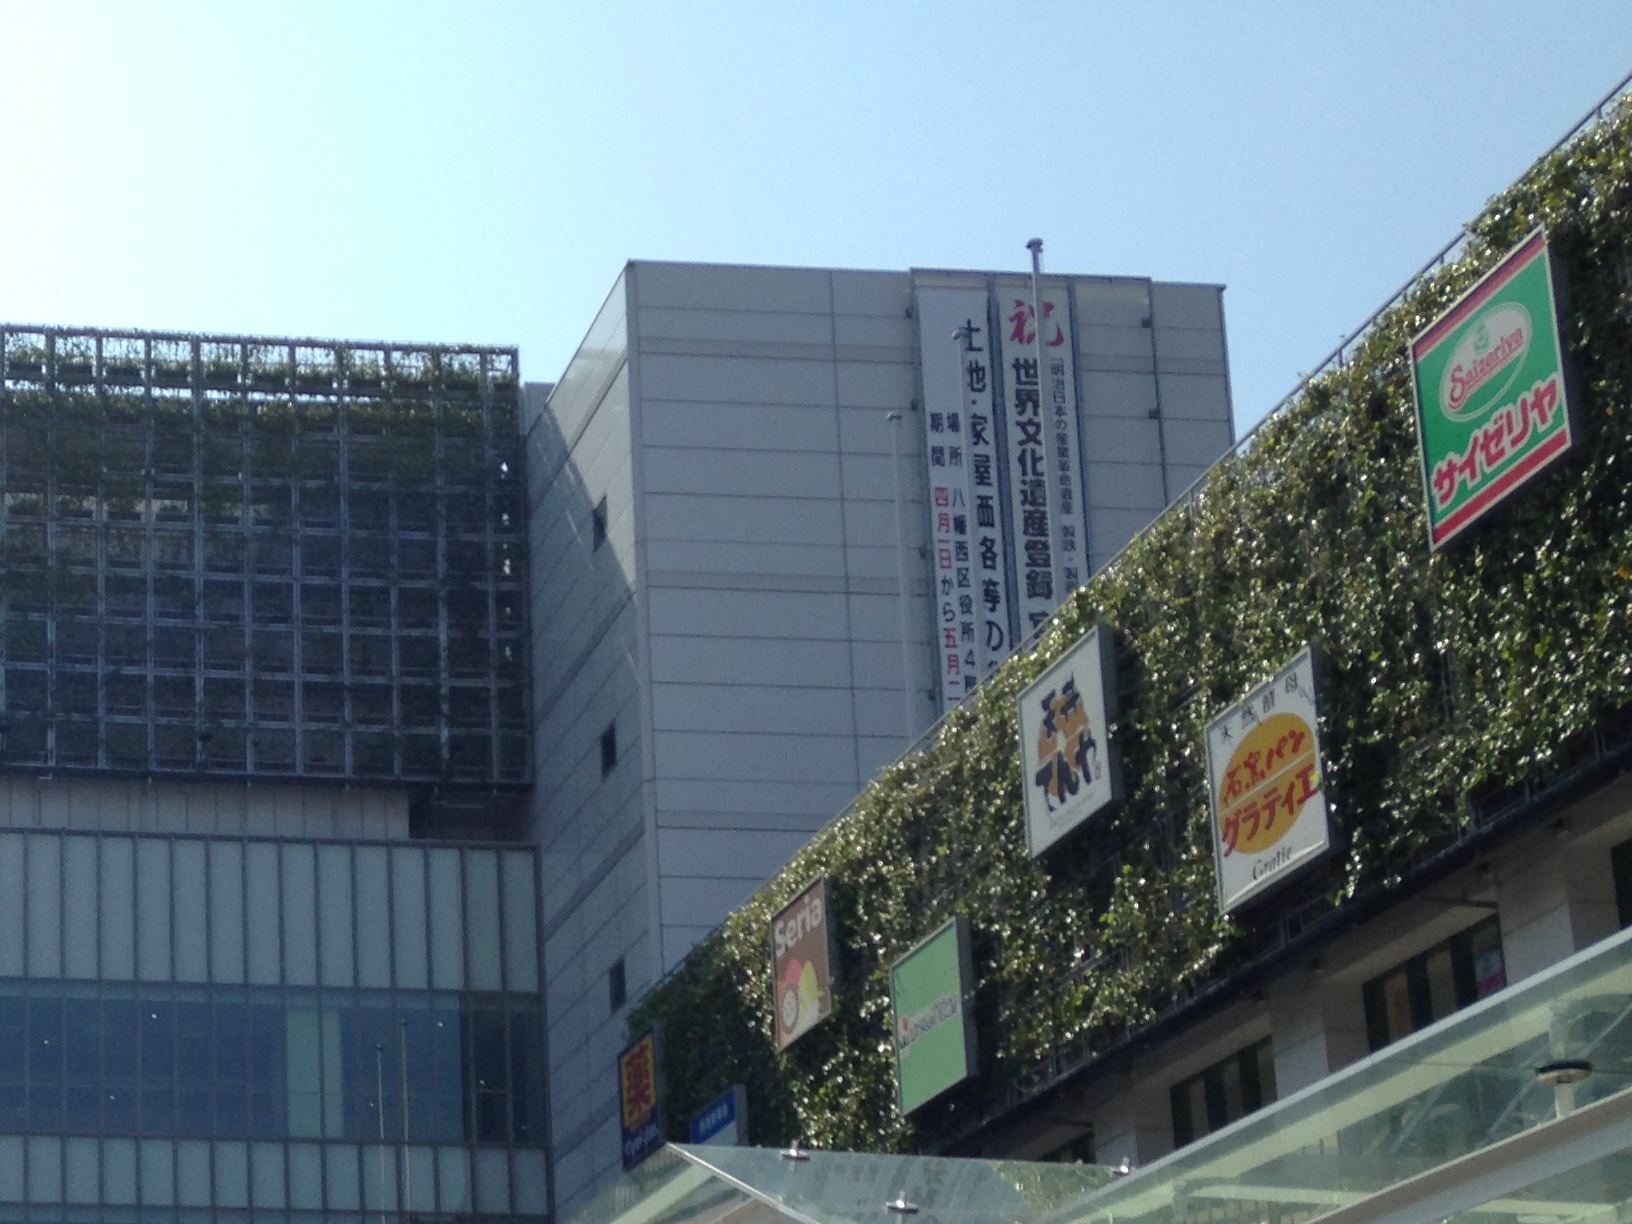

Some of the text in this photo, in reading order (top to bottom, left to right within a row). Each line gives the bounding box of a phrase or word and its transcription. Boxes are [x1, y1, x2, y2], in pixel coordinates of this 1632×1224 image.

[1432, 377, 1559, 506] サイゼリヤ
[1223, 764, 1318, 857] グラティエ
[773, 895, 824, 956] Seria
